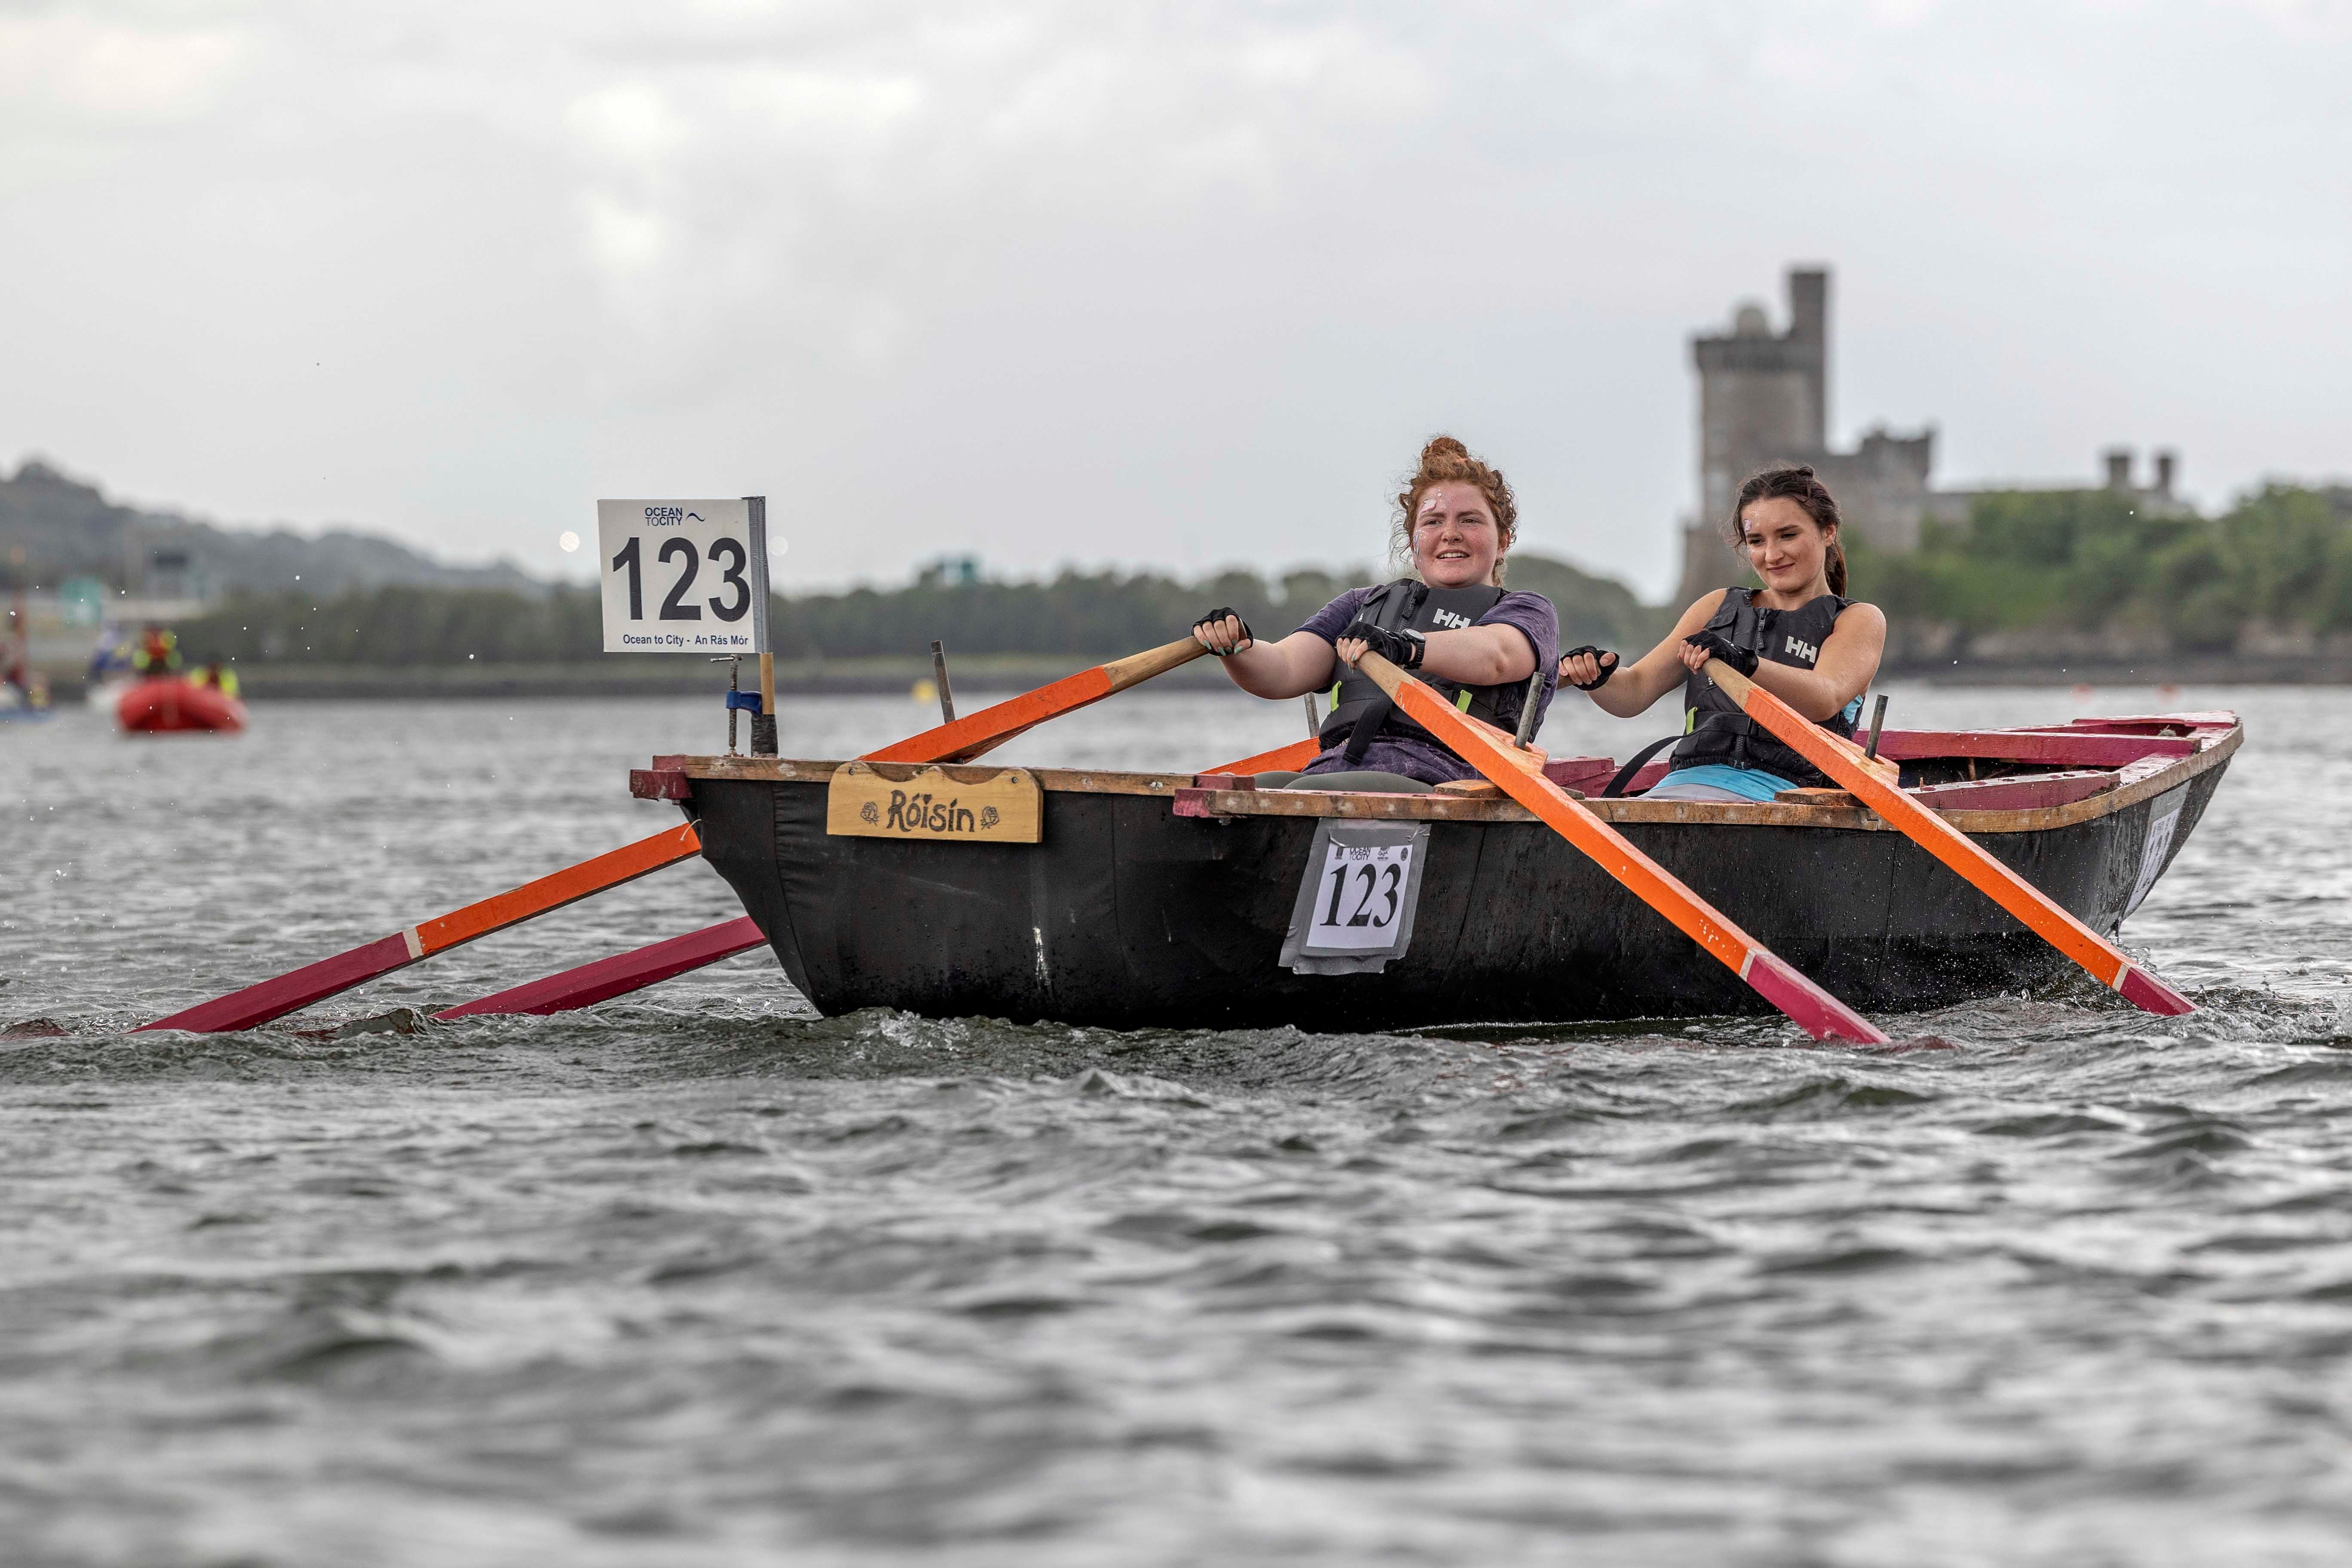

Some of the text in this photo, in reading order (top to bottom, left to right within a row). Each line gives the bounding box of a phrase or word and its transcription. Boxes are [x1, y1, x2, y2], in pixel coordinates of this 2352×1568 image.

[645, 507, 683, 516] OCEAN
[612, 537, 750, 622] 123
[1433, 608, 1471, 629] HH
[623, 634, 652, 644] Ocean
[654, 635, 664, 644] to
[666, 634, 684, 647] City
[695, 635, 708, 645] An
[710, 635, 728, 645] Rás
[731, 635, 749, 645] Mór
[1785, 636, 1817, 663] HH
[886, 790, 975, 832] Róisín
[1319, 863, 1401, 928] 123
